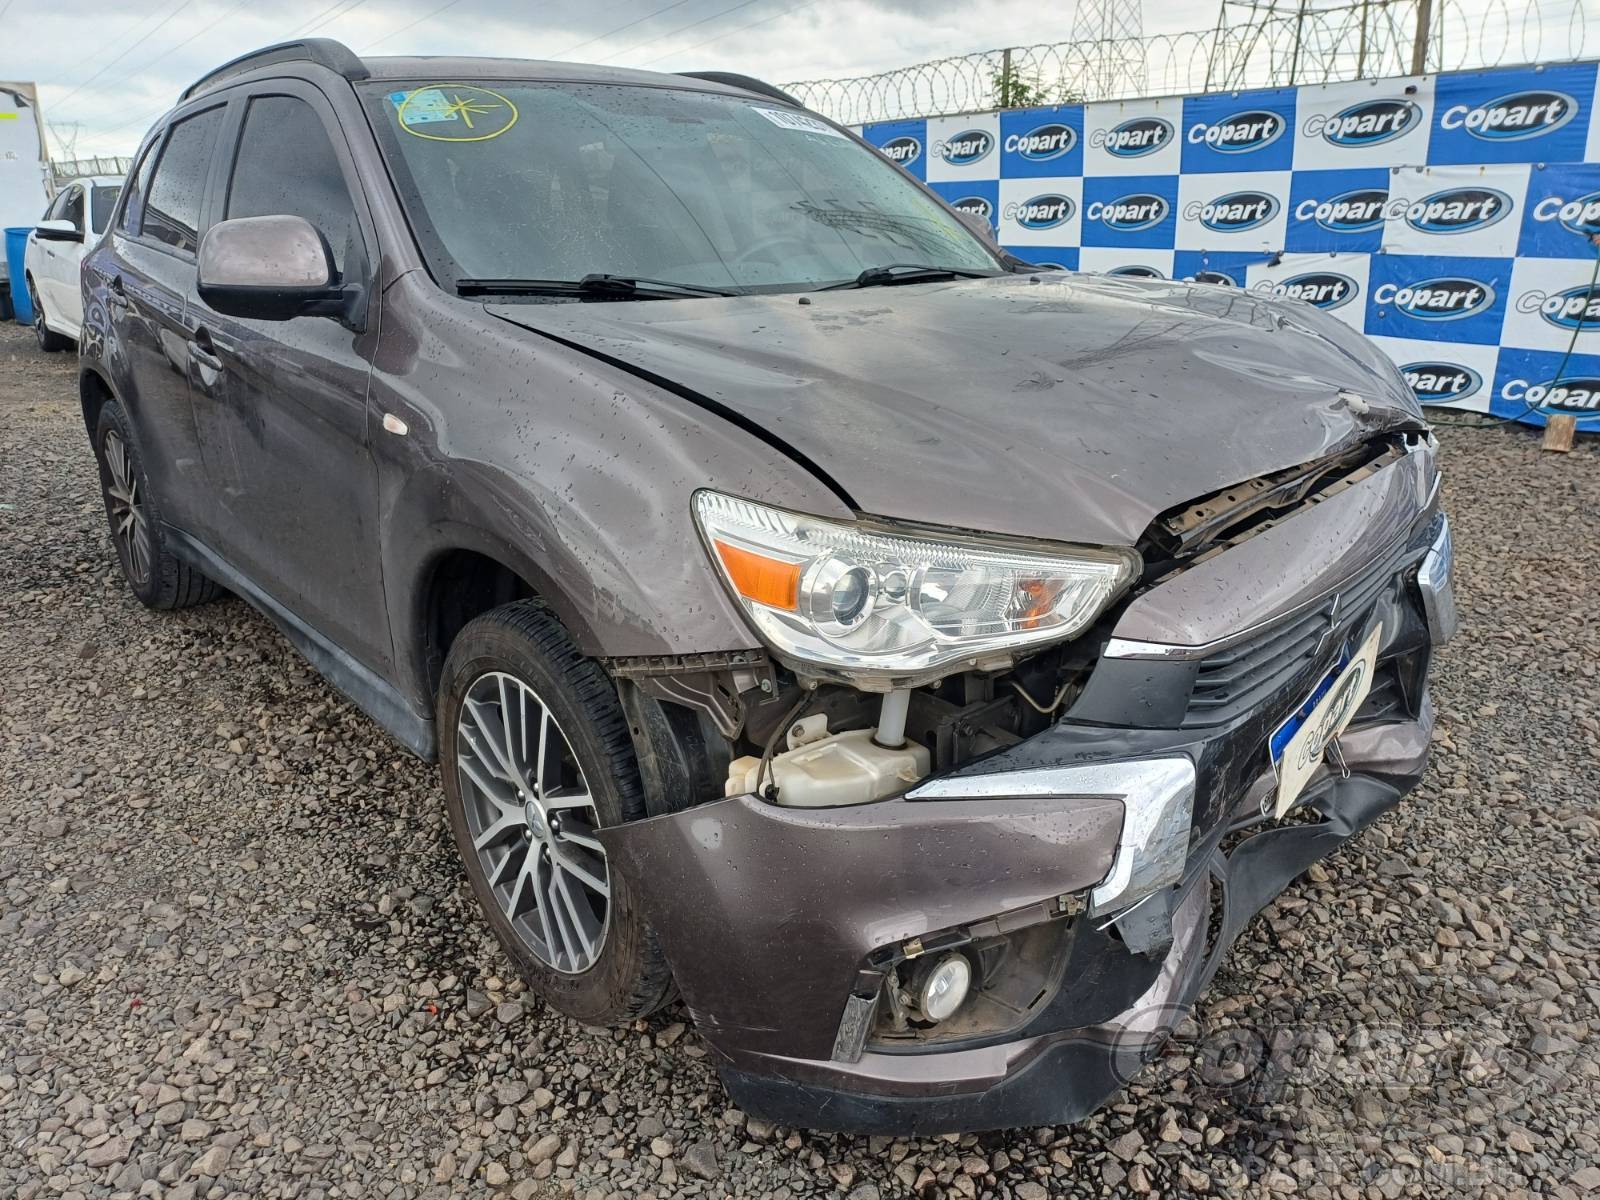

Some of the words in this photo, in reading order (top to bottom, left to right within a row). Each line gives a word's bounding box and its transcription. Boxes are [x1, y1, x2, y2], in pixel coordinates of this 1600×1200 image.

[1303, 109, 1407, 139] Copart
[1440, 98, 1562, 133] Copart
[1005, 131, 1069, 154] Copart
[1089, 123, 1164, 150] Copart
[1188, 118, 1274, 146] Copart
[879, 142, 915, 160] part
[932, 138, 987, 158] Copart
[1004, 199, 1067, 224] Copart
[1086, 199, 1161, 224] Copart
[1183, 199, 1267, 225] Copart
[1384, 198, 1496, 225] Copart
[1374, 282, 1483, 310] Copart
[1402, 372, 1466, 393] part
[1298, 673, 1359, 770] Copart
